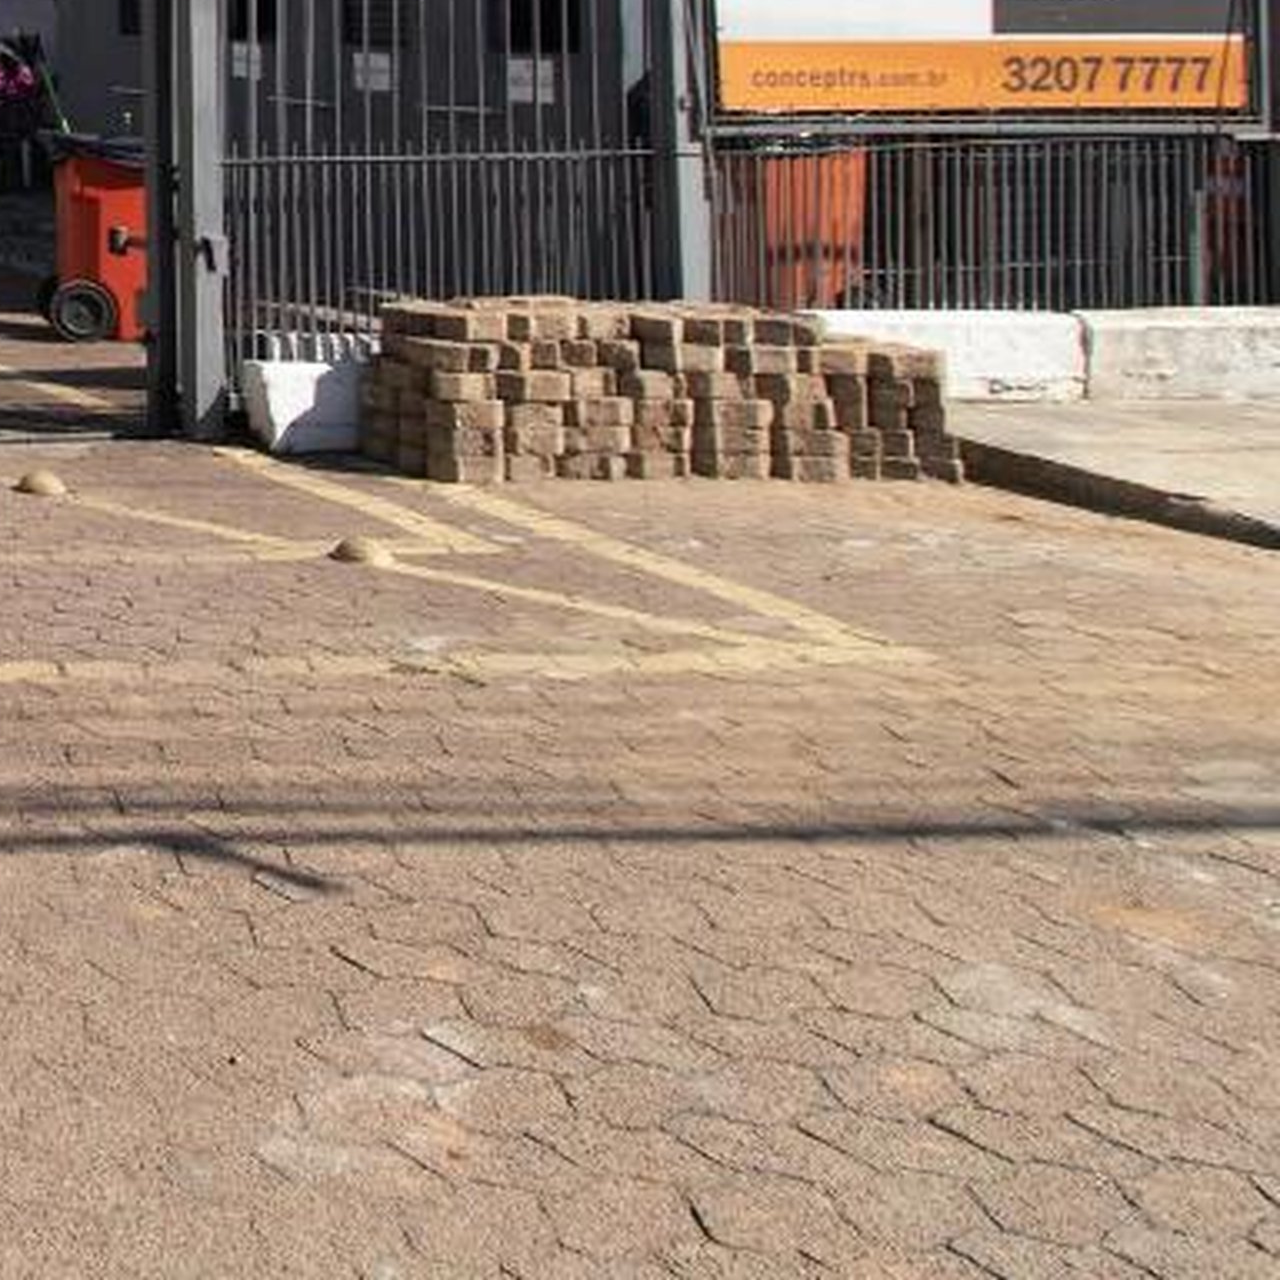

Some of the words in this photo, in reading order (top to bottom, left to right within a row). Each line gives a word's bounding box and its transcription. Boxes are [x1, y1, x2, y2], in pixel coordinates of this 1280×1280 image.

[750, 66, 948, 91] conceptrs.com.br
[1001, 55, 1104, 93] 3207
[1113, 55, 1214, 93] 7777
